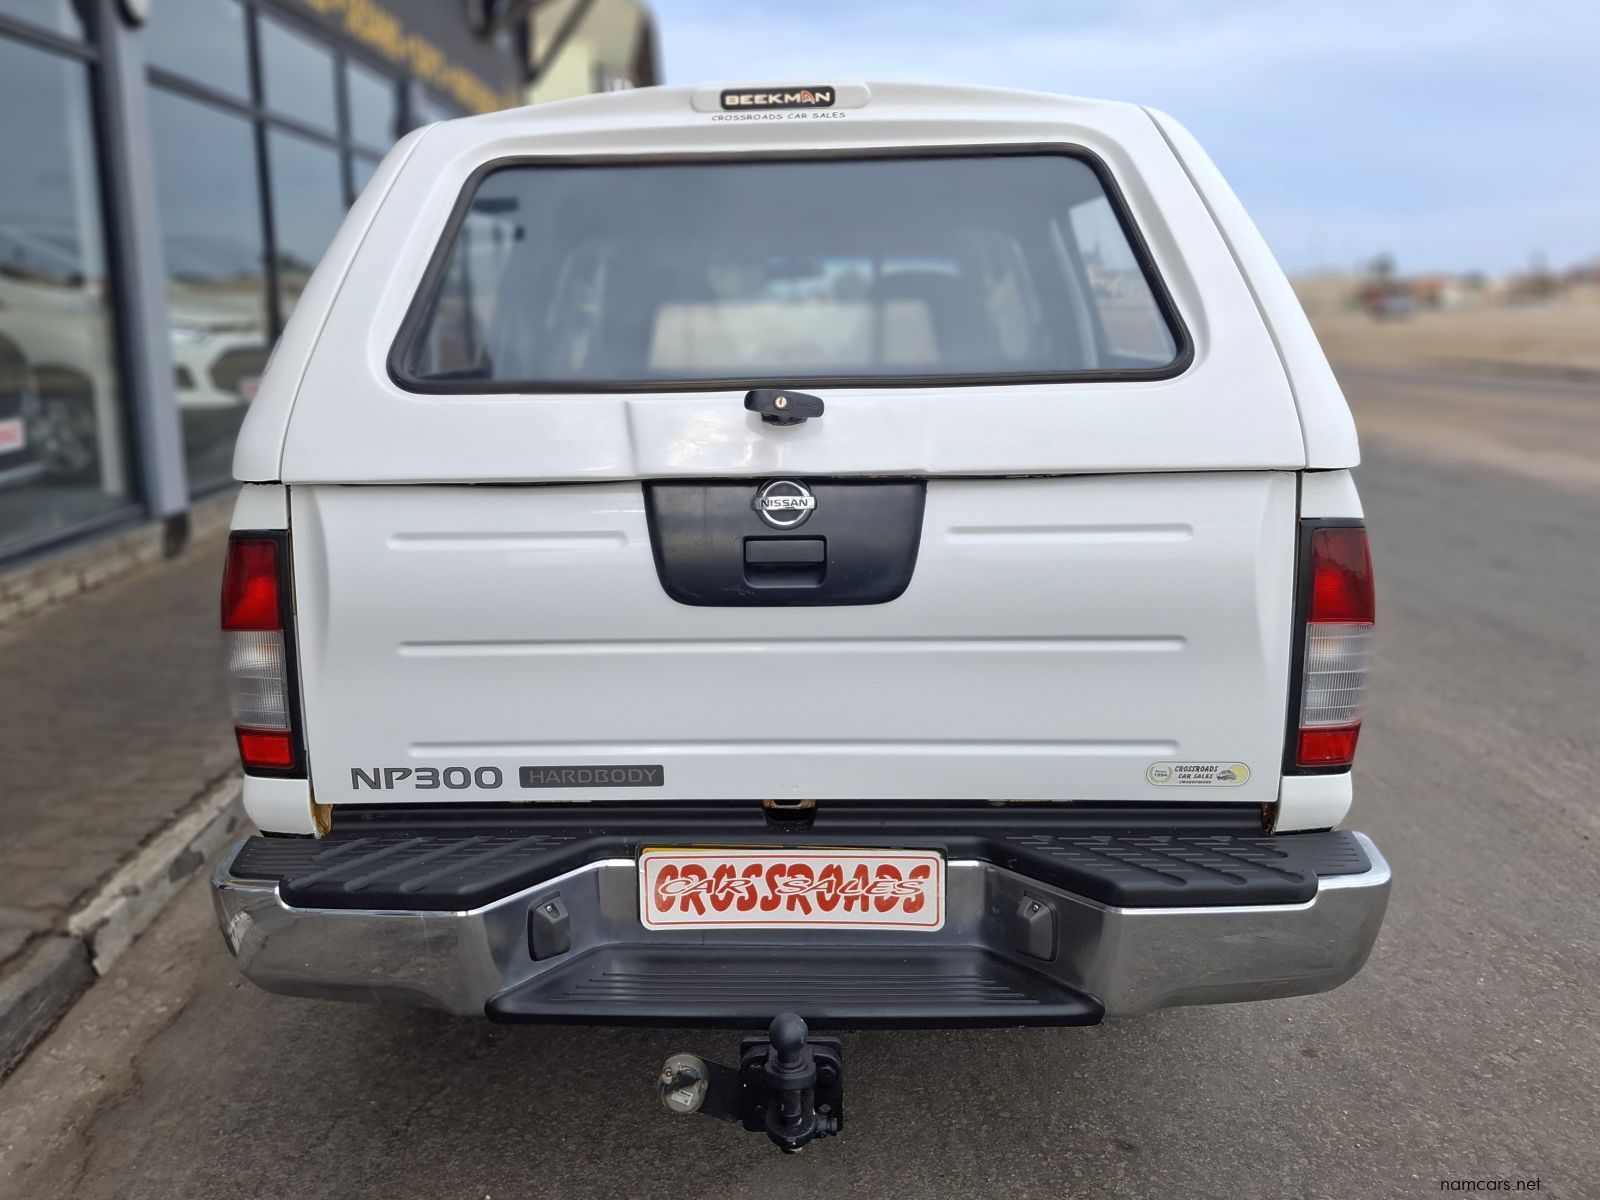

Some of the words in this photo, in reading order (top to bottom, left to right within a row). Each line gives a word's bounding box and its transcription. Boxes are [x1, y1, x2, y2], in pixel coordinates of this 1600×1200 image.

[724, 90, 831, 106] BEEKMAN
[711, 113, 784, 122] CROSSROADS
[787, 112, 808, 120] CAR
[812, 111, 846, 119] SALES
[760, 499, 808, 508] NISSAN
[350, 766, 503, 790] NP300
[528, 768, 658, 785] HARDBODY
[654, 863, 931, 916] CROSSROADS
[658, 877, 753, 896] CAR
[775, 877, 925, 897] SALES
